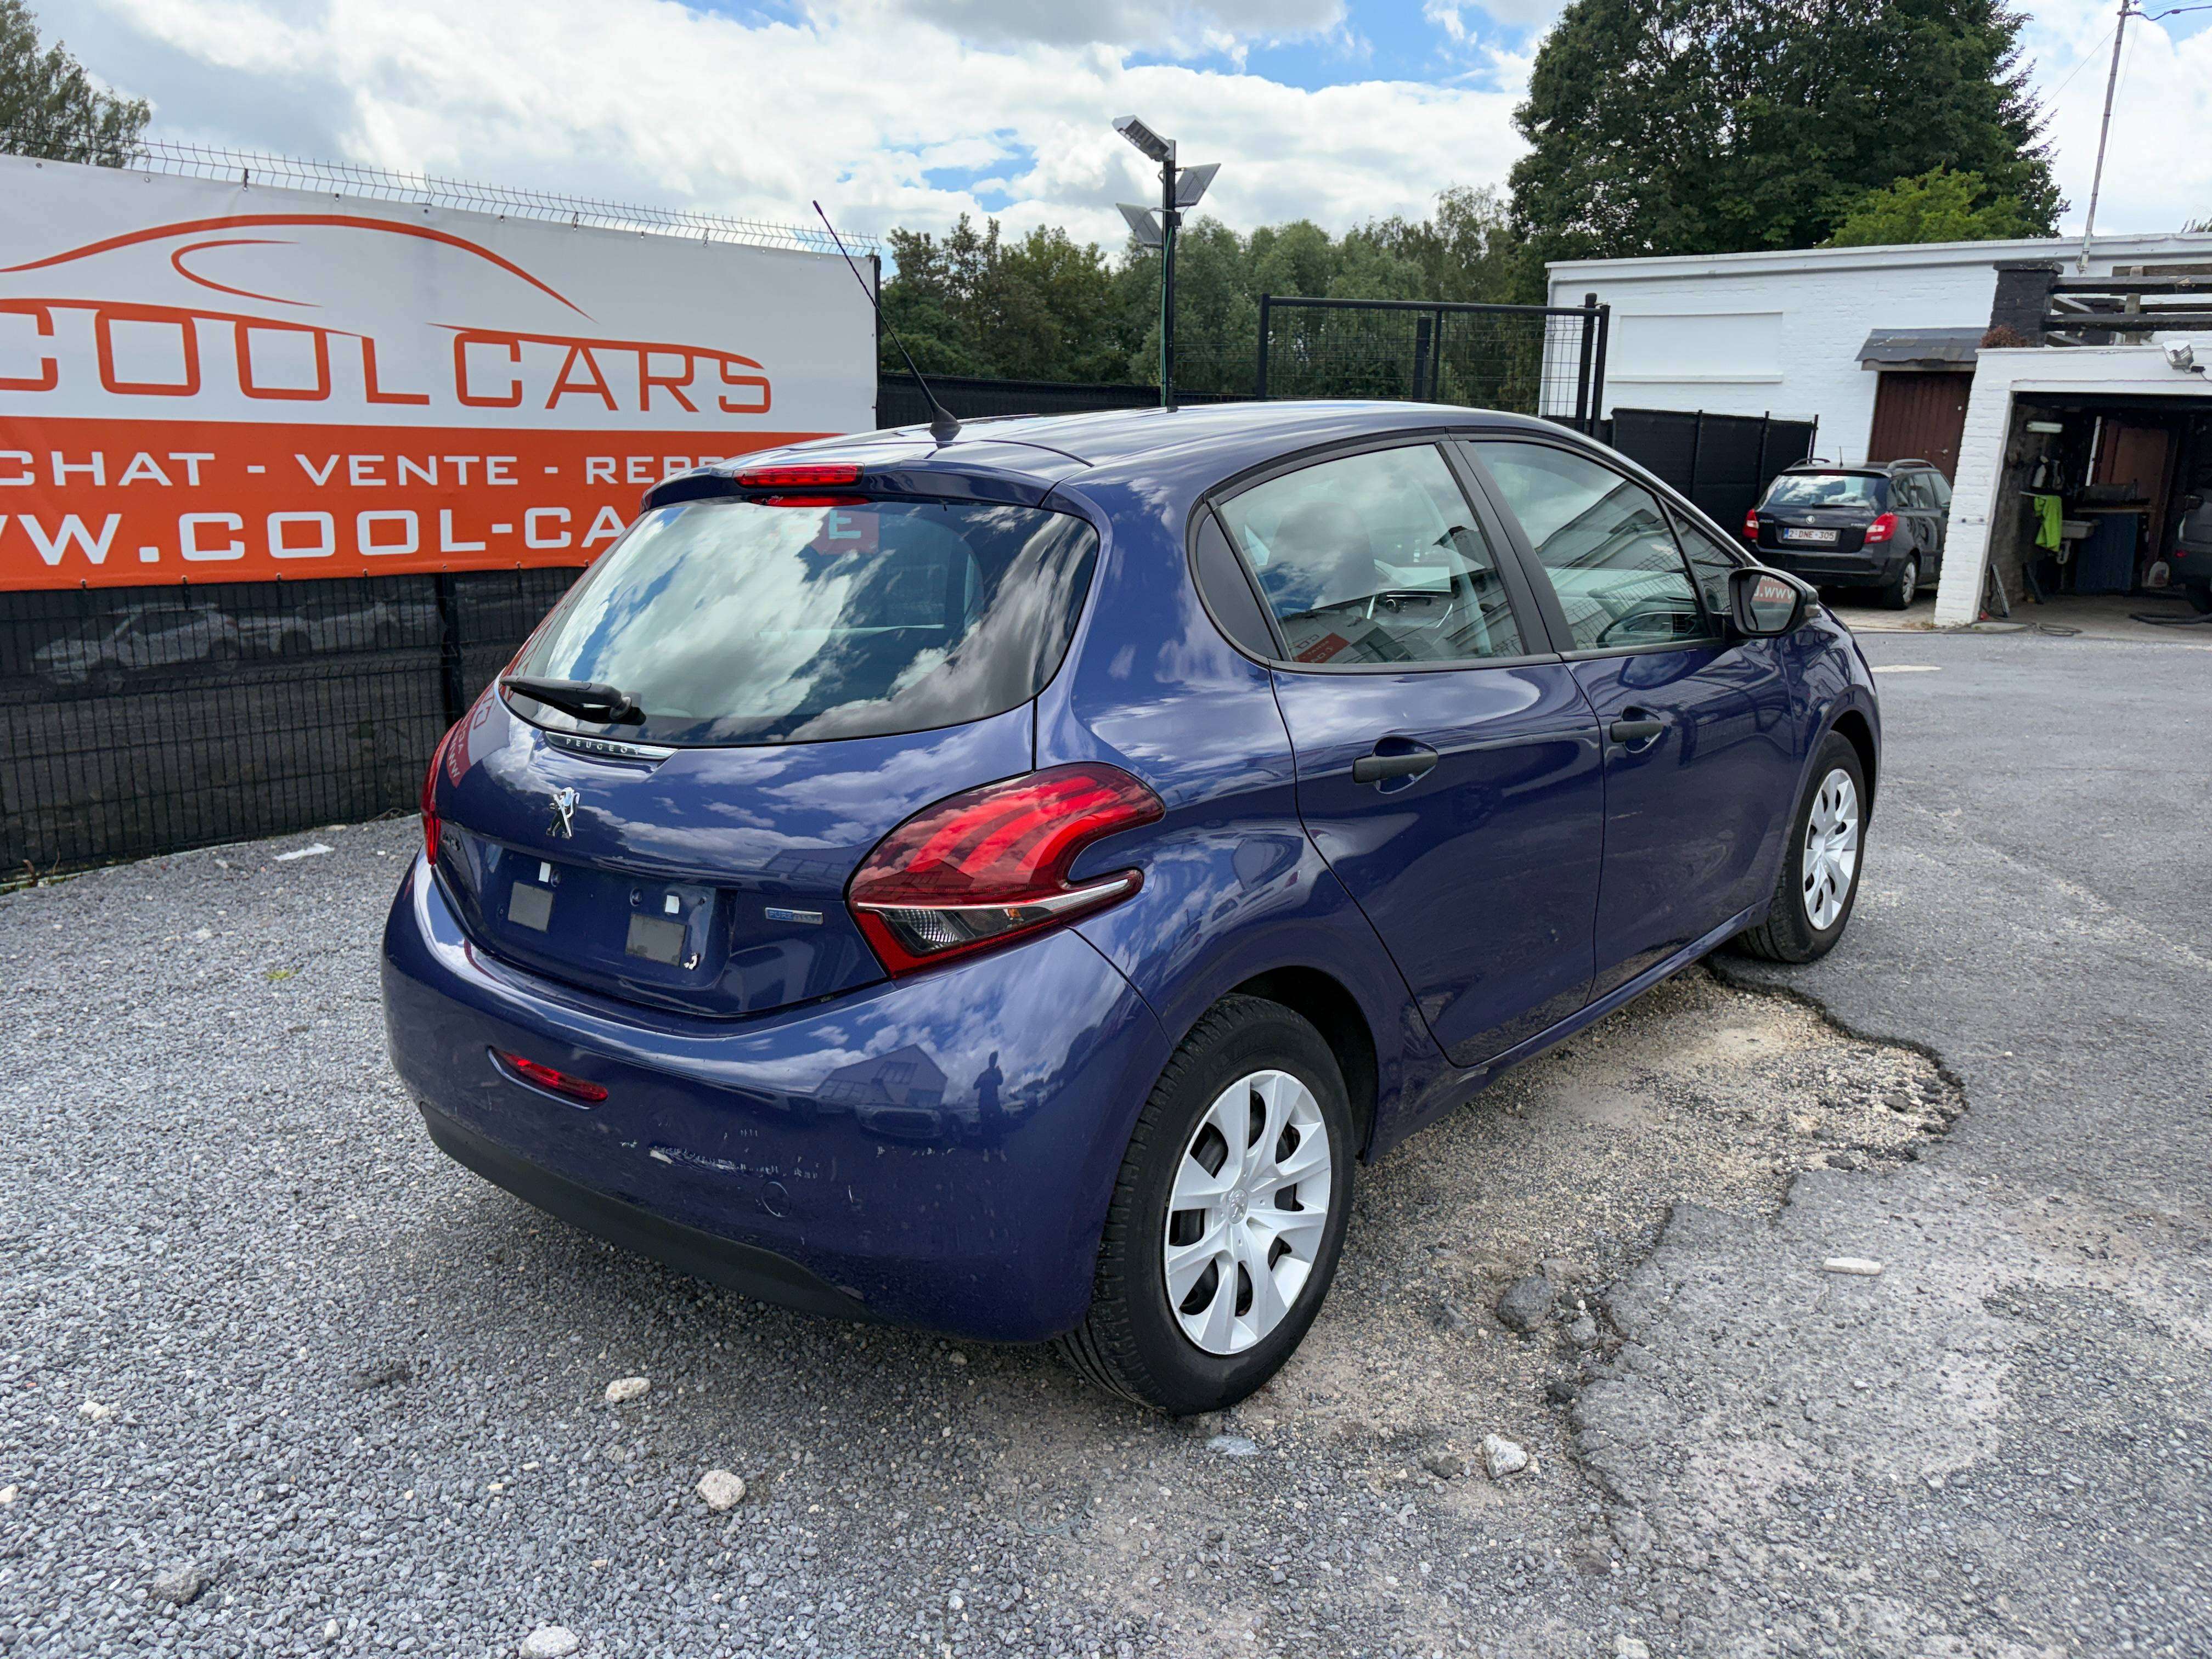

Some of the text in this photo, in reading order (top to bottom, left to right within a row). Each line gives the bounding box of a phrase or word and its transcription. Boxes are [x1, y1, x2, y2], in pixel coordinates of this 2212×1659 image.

[295, 454, 517, 486] VENTE
[0, 505, 626, 566] W.COOL-CA
[566, 738, 640, 755] PEUGEOT
